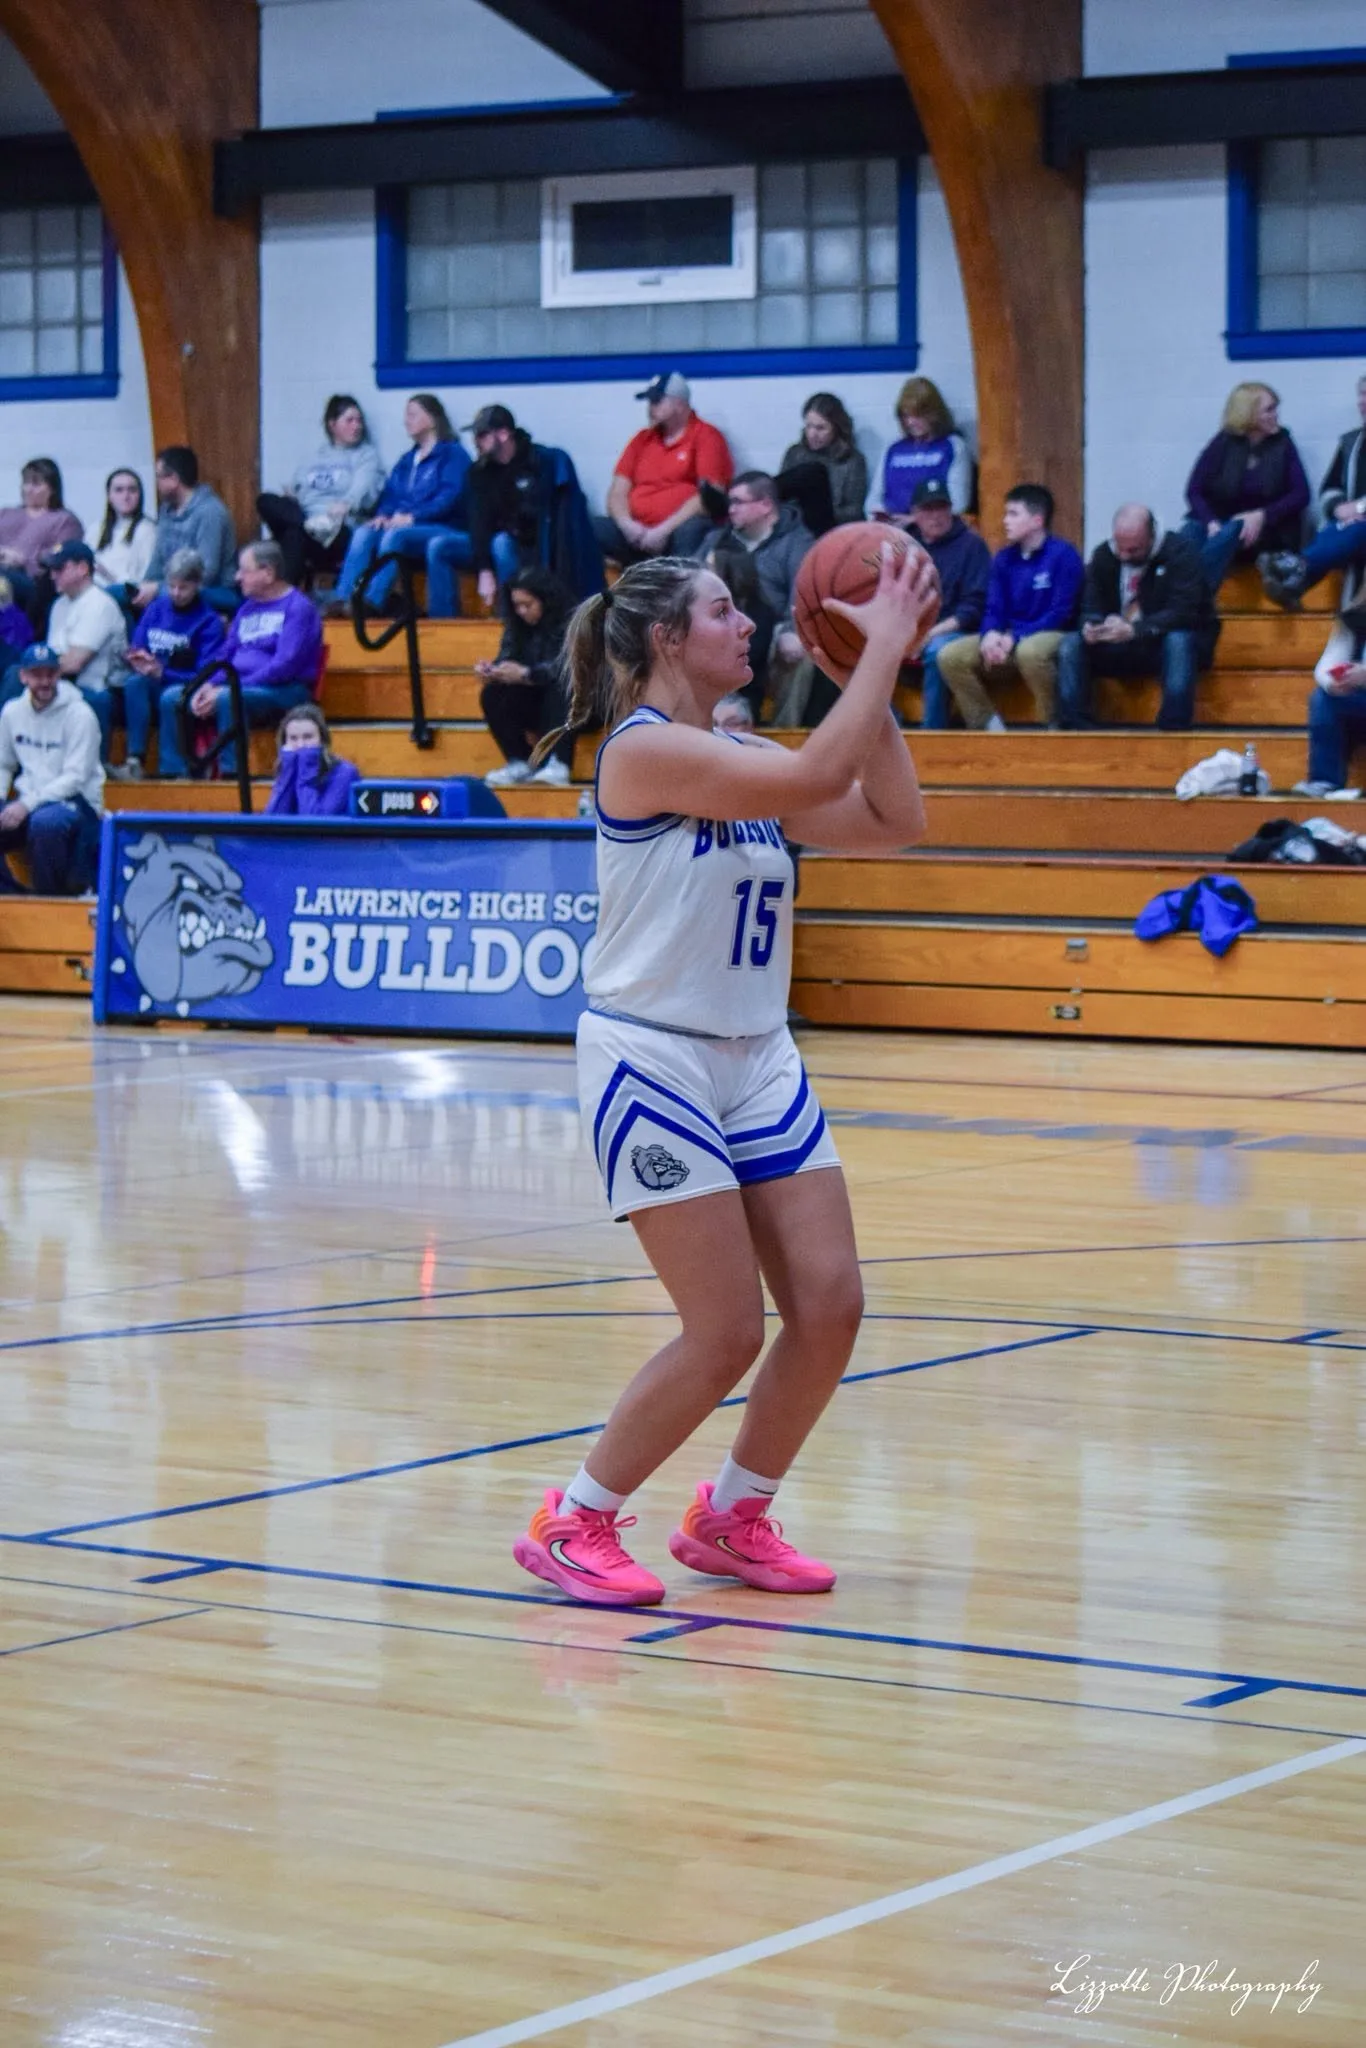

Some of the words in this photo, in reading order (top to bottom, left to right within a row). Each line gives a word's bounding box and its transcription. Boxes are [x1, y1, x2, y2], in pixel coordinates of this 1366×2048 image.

[692, 818, 786, 858] BULLDO
[294, 886, 462, 920] LAWRENCE
[467, 891, 547, 921] HIGH
[729, 877, 786, 969] 15
[283, 921, 597, 997] BULLDO
